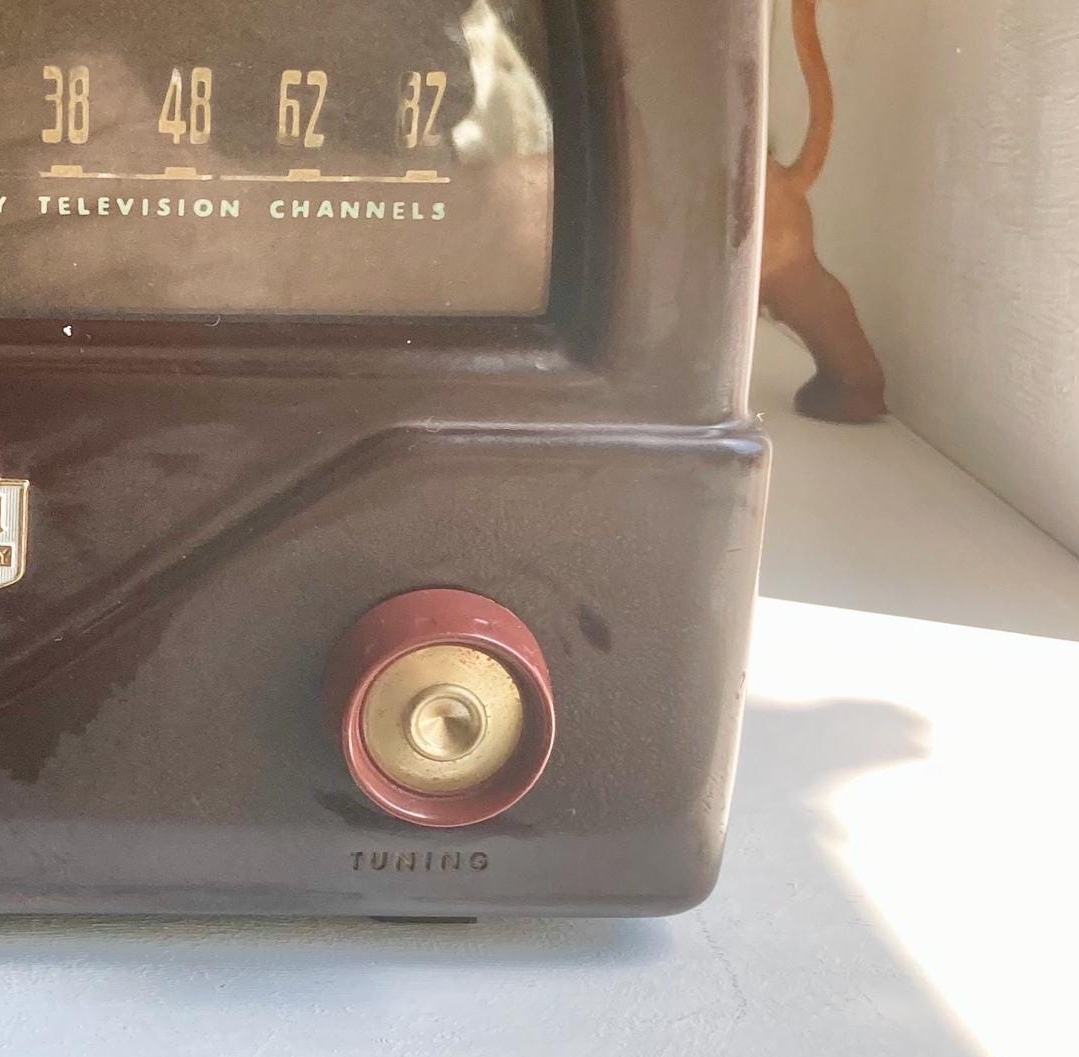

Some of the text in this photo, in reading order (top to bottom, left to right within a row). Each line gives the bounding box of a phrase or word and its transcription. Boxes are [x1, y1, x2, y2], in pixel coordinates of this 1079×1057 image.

[42, 65, 89, 144] 38
[158, 67, 212, 144] 48
[277, 70, 328, 147] 62
[38, 195, 240, 218] TELEVISION
[269, 200, 446, 220] CHANNELS
[350, 851, 489, 872] TUNING
